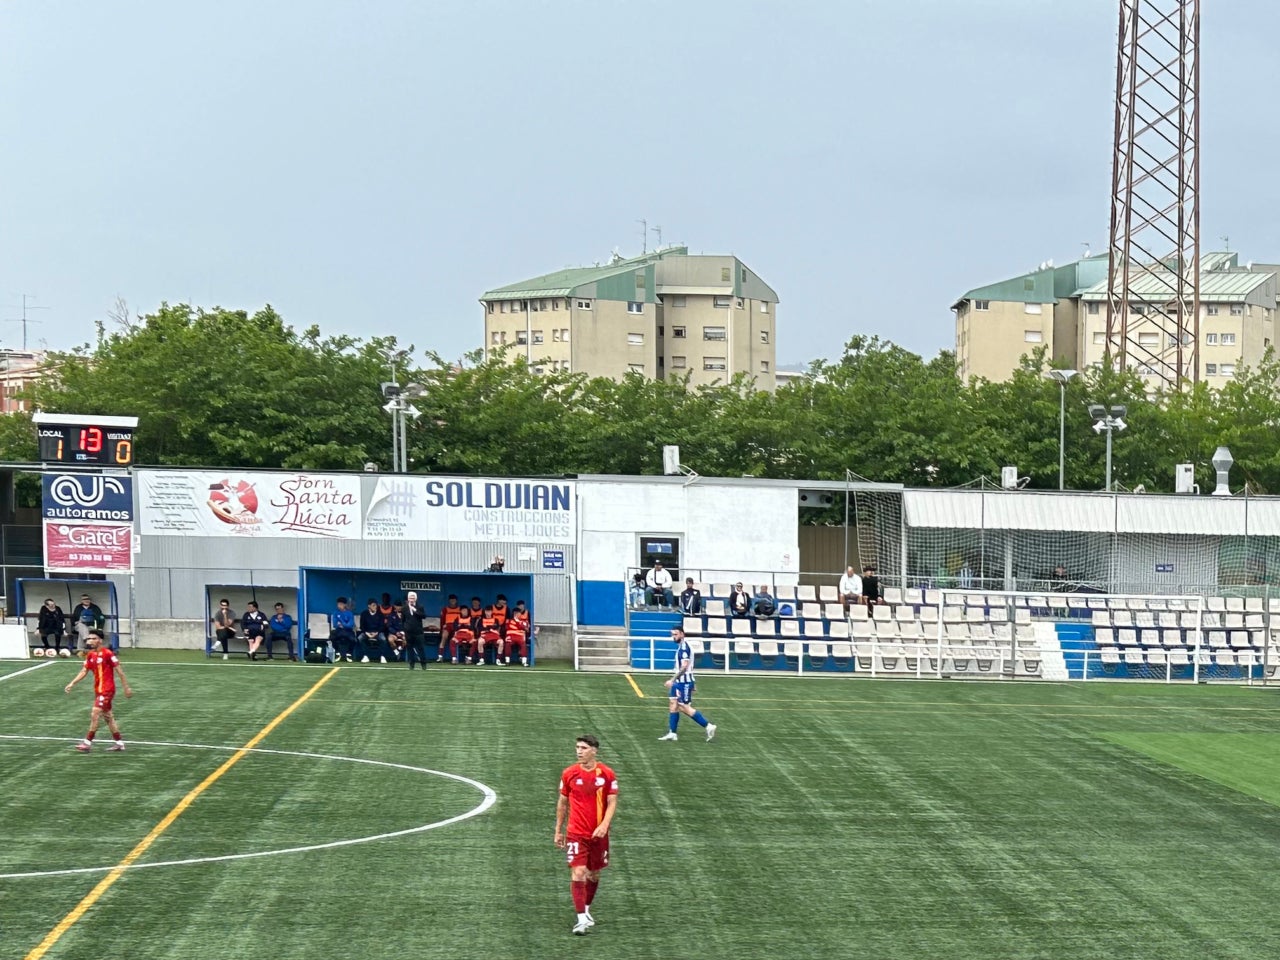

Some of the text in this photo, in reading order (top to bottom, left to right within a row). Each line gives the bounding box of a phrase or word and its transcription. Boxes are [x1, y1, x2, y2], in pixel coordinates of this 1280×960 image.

[38, 430, 64, 438] LOCAL
[80, 428, 102, 452] 13
[57, 439, 63, 460] 1
[116, 440, 131, 463] 0
[271, 480, 357, 507] Santa
[46, 507, 130, 519] autoramos
[463, 509, 570, 524] CONSTRUCCIONS
